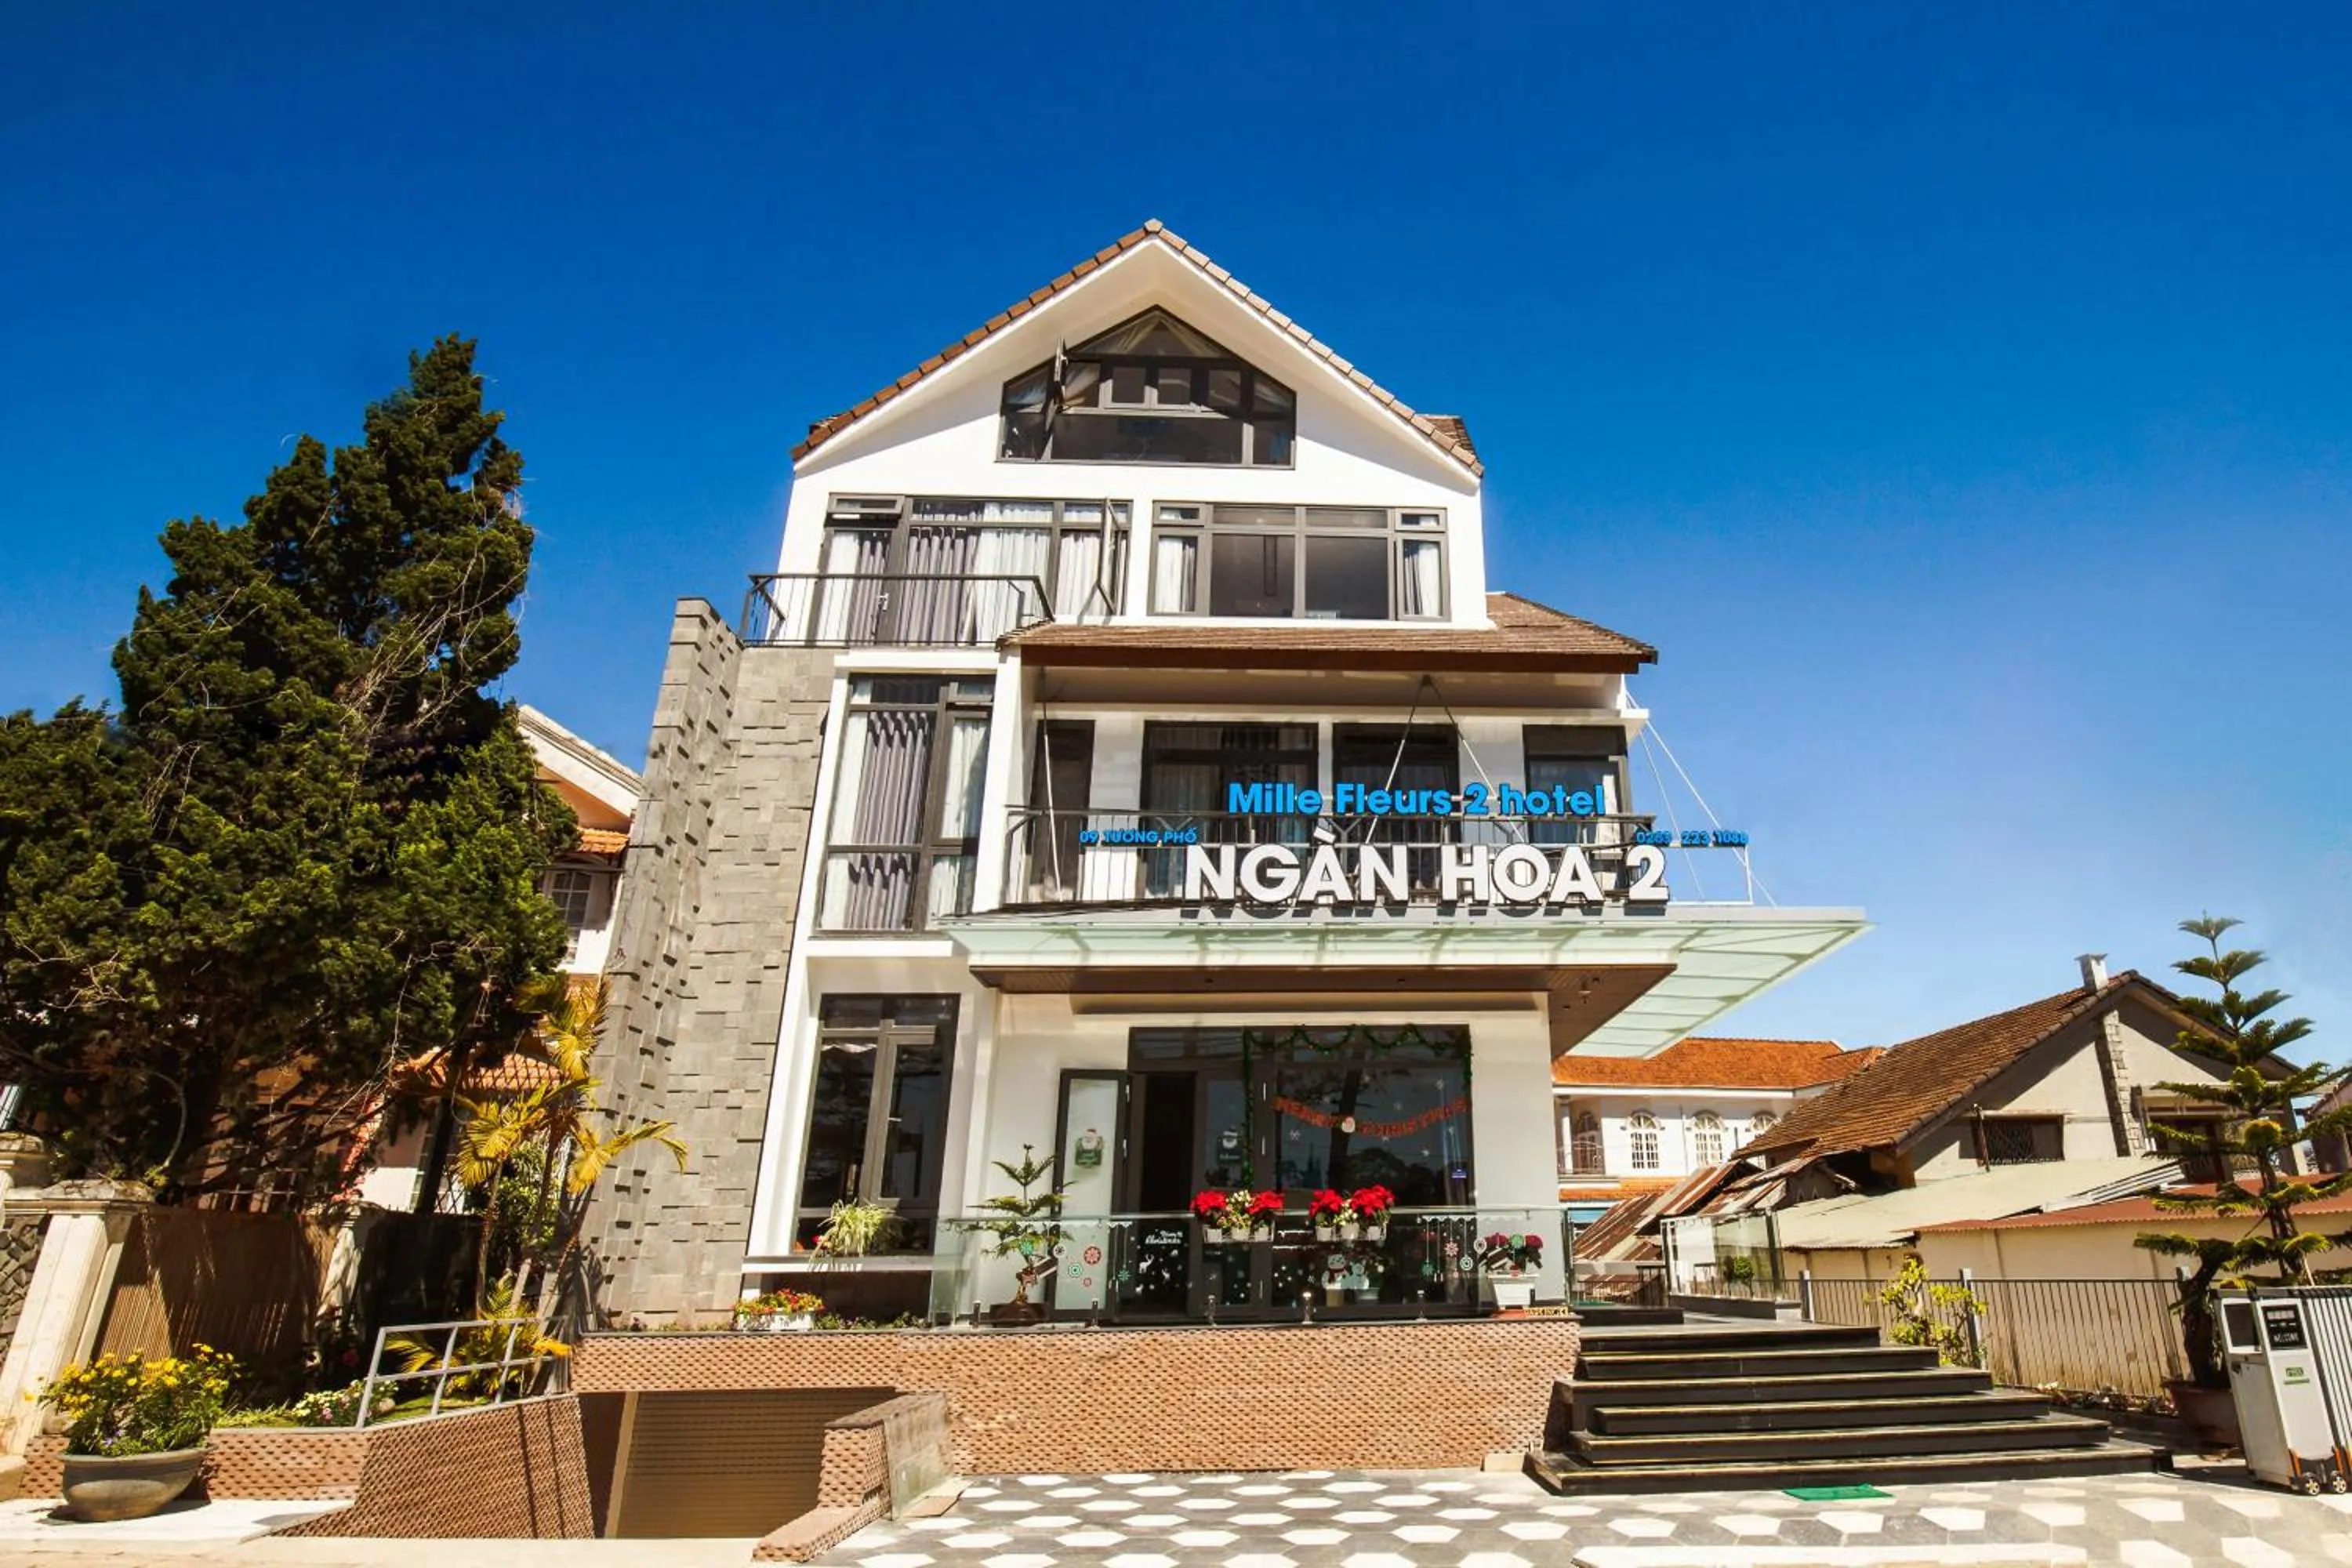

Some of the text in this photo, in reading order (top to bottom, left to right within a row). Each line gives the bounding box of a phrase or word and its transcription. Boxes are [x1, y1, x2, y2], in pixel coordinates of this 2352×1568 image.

[1228, 781, 1606, 815] Mille Fleurs 2 hotel
[1079, 830, 1098, 844] 09
[1162, 826, 1198, 844] PHỐ
[1681, 829, 1711, 845] 223
[1185, 825, 1669, 902] NGÀN HOA 2
